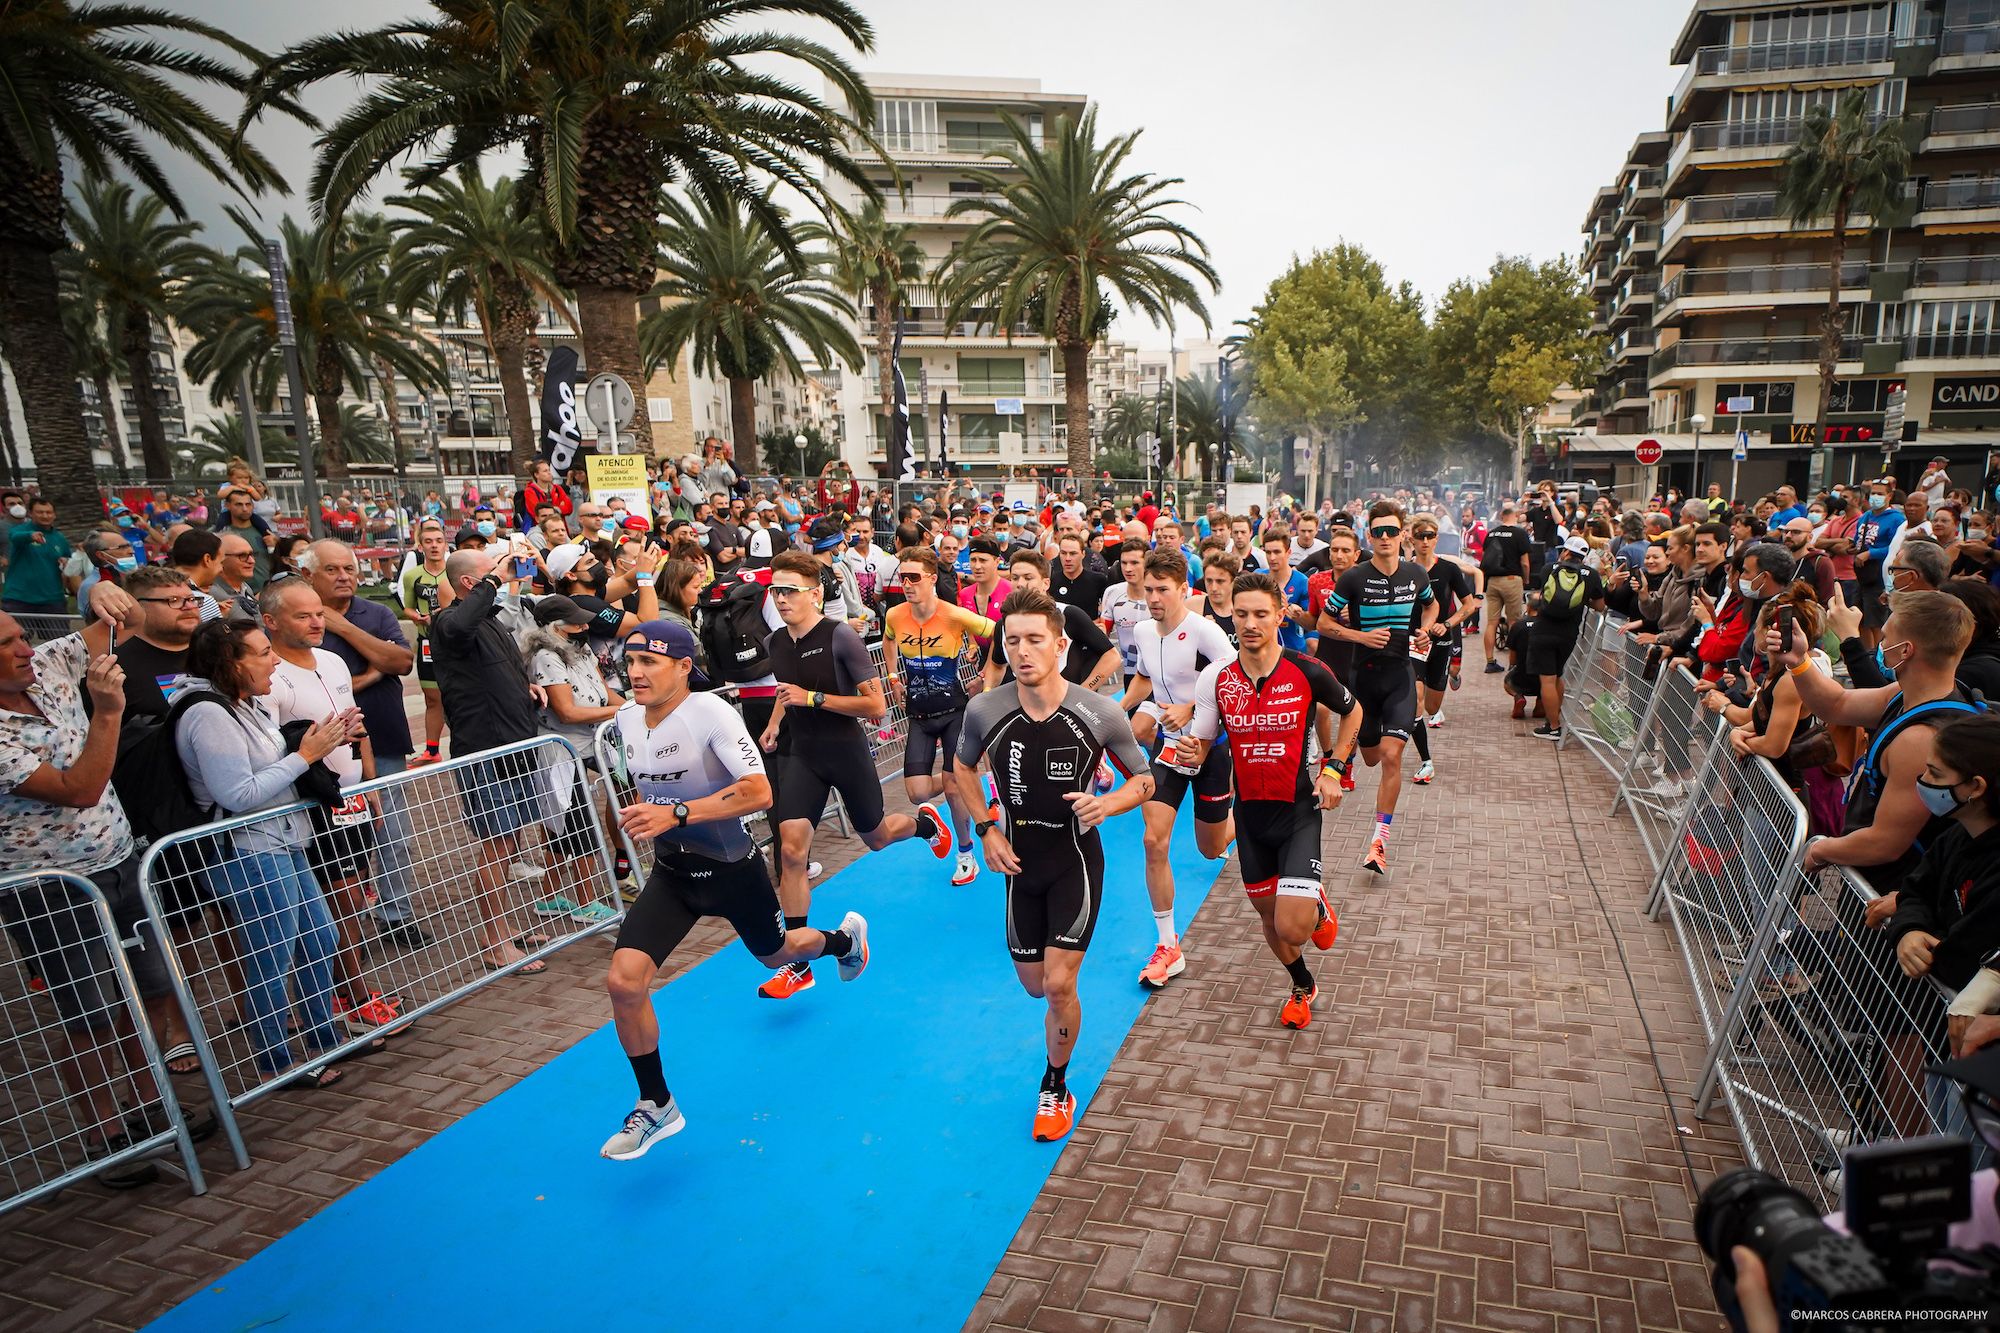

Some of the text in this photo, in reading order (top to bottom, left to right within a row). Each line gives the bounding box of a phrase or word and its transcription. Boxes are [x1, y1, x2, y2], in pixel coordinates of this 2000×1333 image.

[1938, 384, 2000, 403] CAND
[1637, 448, 1661, 456] STOP
[598, 457, 635, 467] ATENCIÓ
[1267, 695, 1303, 706] LOOK
[1075, 702, 1102, 726] teamline
[1226, 711, 1300, 727] ROUGEOT
[1063, 714, 1084, 741] HUUB
[1240, 743, 1286, 758] TEB
[639, 770, 688, 781] FELT
[1011, 740, 1027, 806] teamline
[1028, 820, 1064, 829] WINGER
[1059, 1028, 1068, 1038] 4
